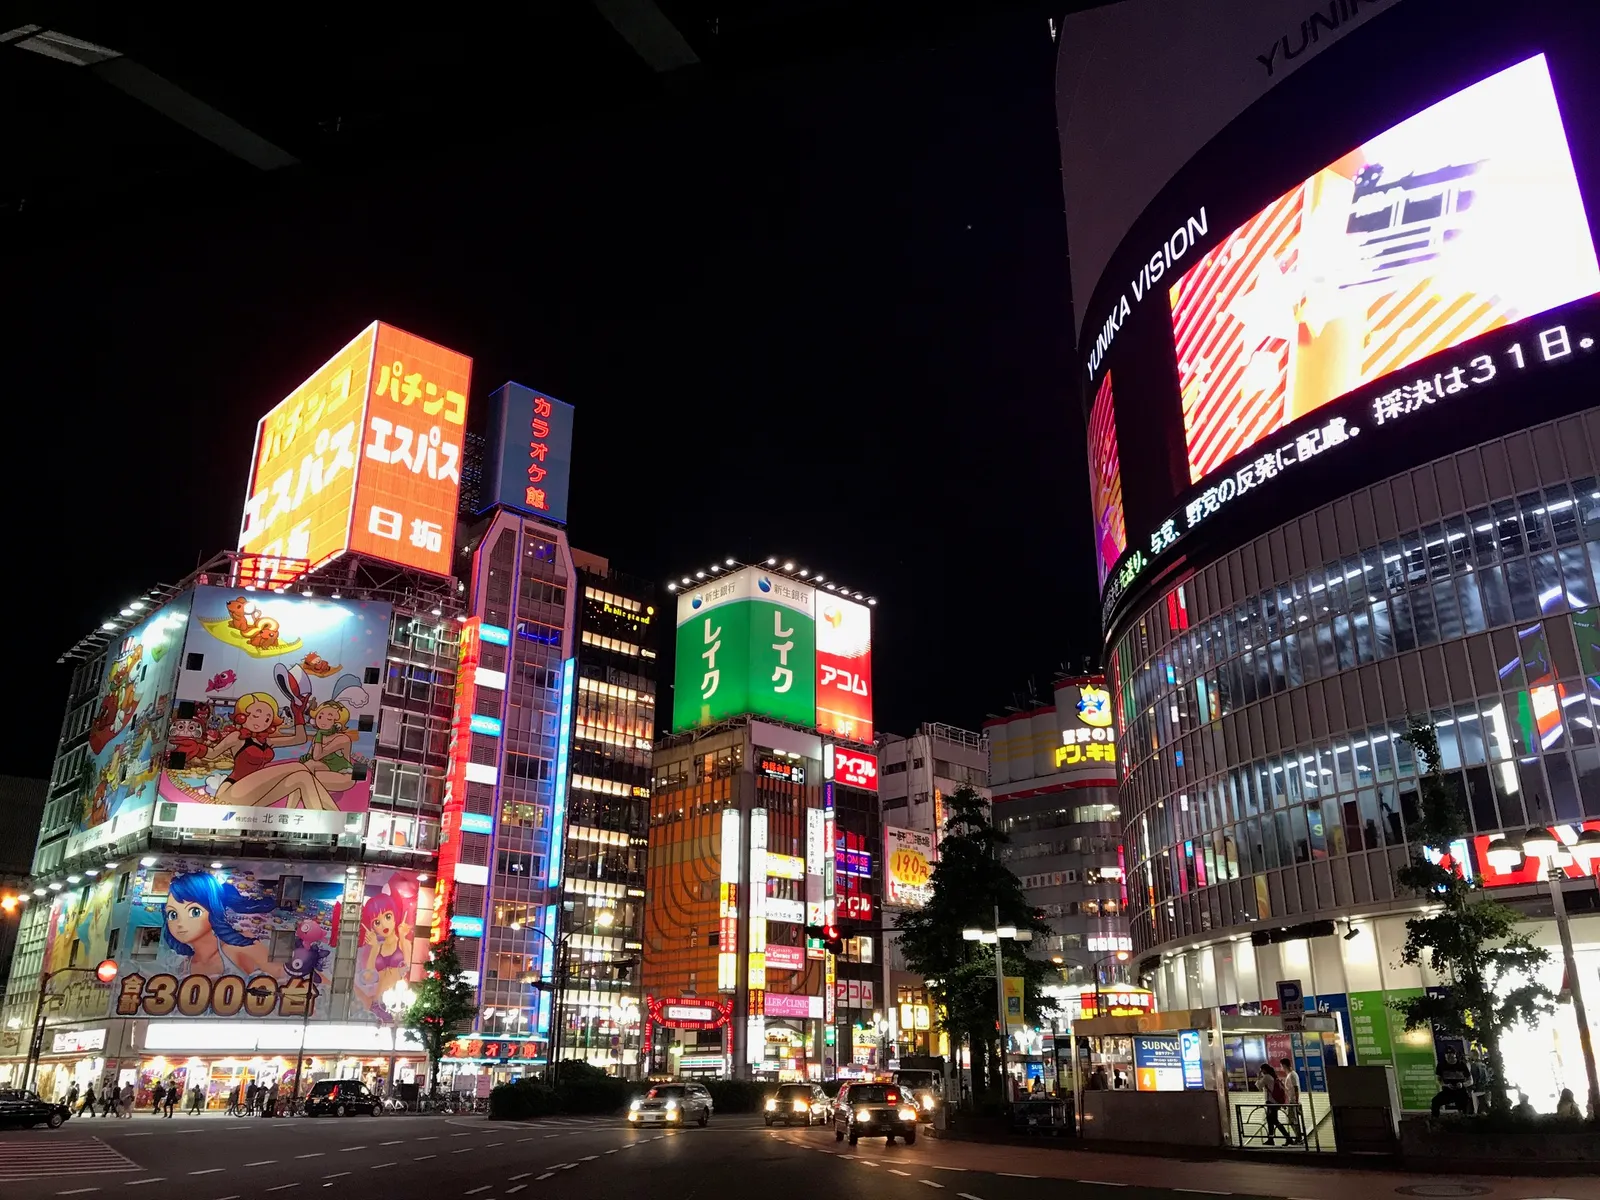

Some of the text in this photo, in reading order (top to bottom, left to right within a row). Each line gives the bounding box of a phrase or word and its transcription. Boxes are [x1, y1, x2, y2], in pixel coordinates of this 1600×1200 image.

[1087, 206, 1208, 381] YUNIKA VISION
[259, 367, 353, 469] パチンコ
[375, 361, 466, 425] パチンコ
[366, 417, 459, 485] エスパス
[526, 397, 552, 509] カラオケ館
[239, 421, 356, 549] エスパス
[705, 582, 736, 603] 新生銀行
[774, 584, 809, 604] 新生銀行
[701, 618, 721, 700] レイク
[772, 610, 794, 693] レイク
[820, 664, 868, 696] アコム
[836, 753, 876, 777] アイフル
[837, 984, 872, 999] アコム
[1318, 1000, 1330, 1013] 4F
[1350, 998, 1363, 1010] 5F
